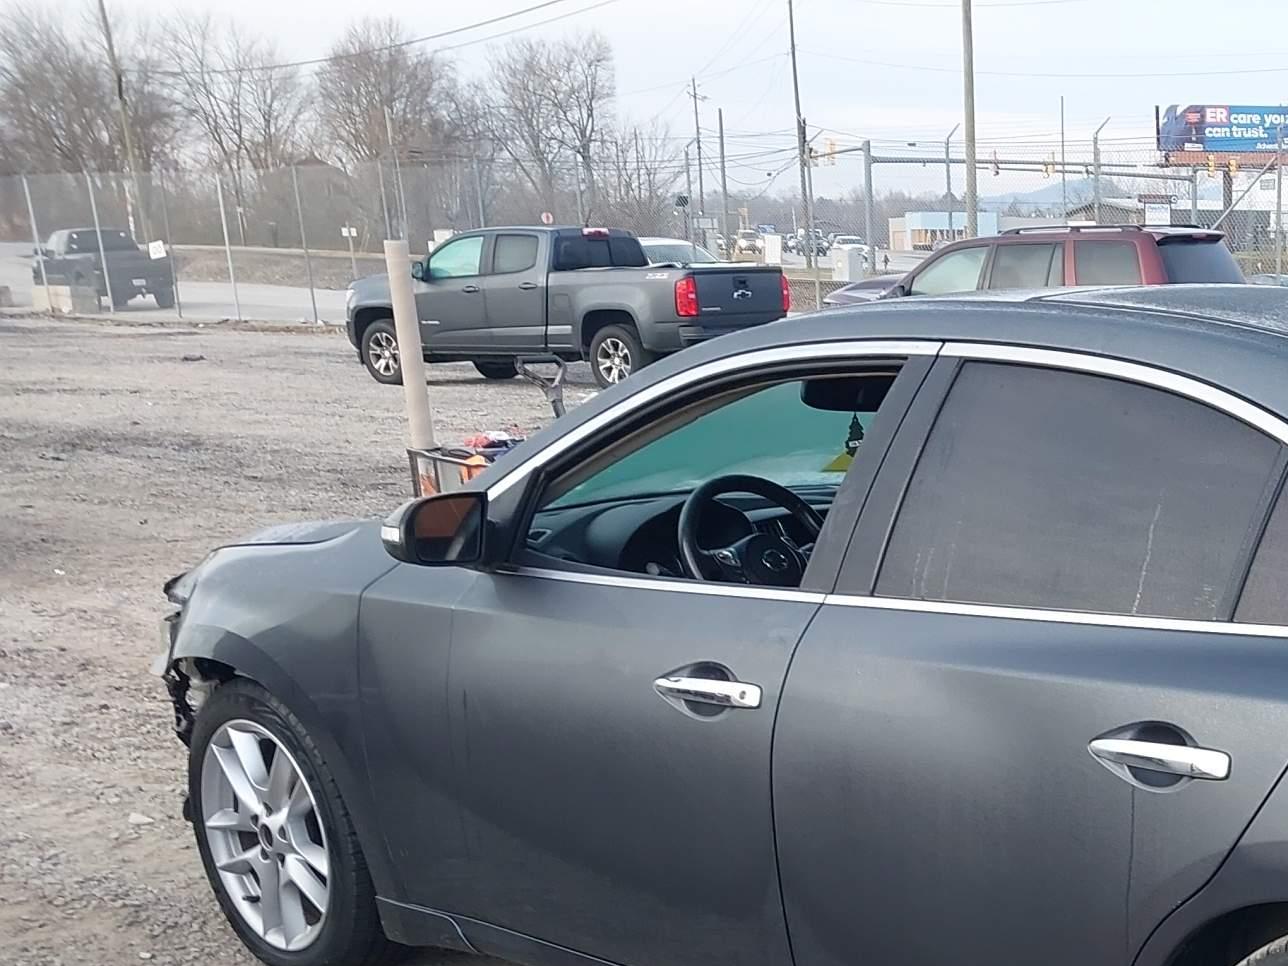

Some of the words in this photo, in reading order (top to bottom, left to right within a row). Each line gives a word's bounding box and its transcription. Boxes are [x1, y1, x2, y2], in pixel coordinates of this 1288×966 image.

[1205, 107, 1228, 122] ER
[1230, 113, 1261, 124] care
[1204, 126, 1230, 137] can
[1231, 125, 1268, 138] trust.
